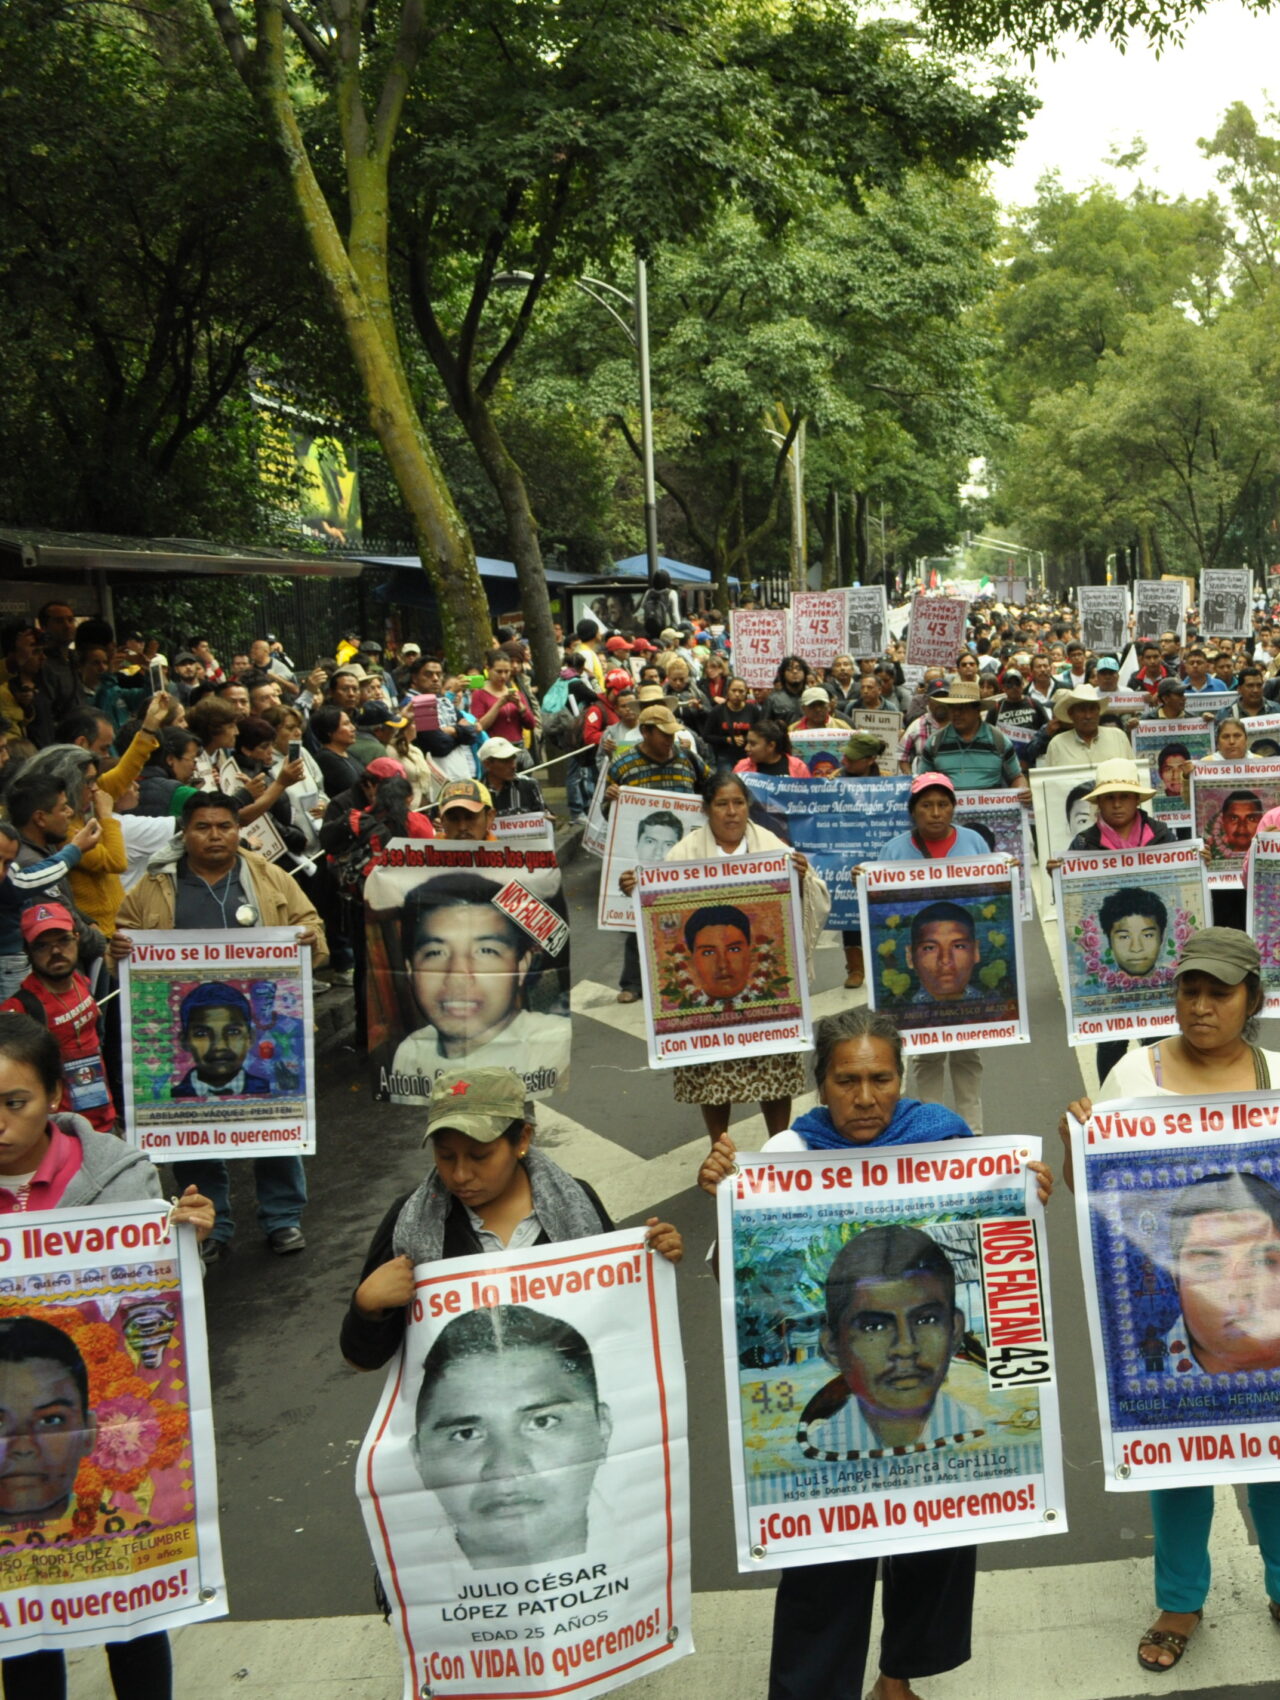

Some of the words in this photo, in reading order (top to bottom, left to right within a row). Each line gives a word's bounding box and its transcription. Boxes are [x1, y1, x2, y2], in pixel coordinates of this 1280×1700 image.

[809, 620, 830, 634] 43
[927, 622, 947, 636] 43
[750, 639, 771, 654] 43
[640, 867, 680, 886] ¡Vivo
[684, 867, 700, 880] se
[704, 865, 718, 878] lo
[723, 858, 787, 876] llevaron!
[496, 881, 523, 915] NOS
[517, 896, 559, 941] FALTAN
[131, 946, 175, 963] ¡Vivo
[181, 945, 199, 960] se
[205, 945, 220, 960] lo
[225, 944, 298, 960] llevaron!
[380, 1066, 433, 1097] Antonio
[149, 1111, 198, 1120] ABELARDO
[1088, 1112, 1156, 1144] ¡Vivo
[1165, 1113, 1193, 1135] se
[1199, 1106, 1224, 1133] lo
[141, 1133, 171, 1149] ¡Con
[176, 1131, 210, 1147] VIDA
[214, 1129, 228, 1144] lo
[230, 1126, 301, 1146] queremos!
[736, 1164, 813, 1200] ¡Vivo
[821, 1166, 853, 1190] se
[862, 1160, 888, 1188] lo
[897, 1149, 1021, 1185] llevaron!
[740, 1215, 757, 1224] Yo,
[762, 1213, 778, 1222] Jan
[782, 1211, 813, 1221] Nimmo,
[817, 1208, 859, 1219] Glasgow,
[939, 1198, 969, 1208] saber
[999, 1192, 1018, 1202] está
[22, 1216, 171, 1260] llevaron!
[982, 1220, 1036, 1266] NOS
[429, 1290, 461, 1317] se
[471, 1281, 500, 1311] lo
[510, 1255, 642, 1304] llevaron!
[986, 1269, 1043, 1347] FALTAN
[989, 1346, 1052, 1389] 43!
[751, 1380, 795, 1413] 43
[1120, 1399, 1170, 1412] MIGUEL
[1123, 1440, 1172, 1466] ¡Con
[1178, 1434, 1236, 1462] VIDA
[1240, 1432, 1261, 1458] lo
[795, 1475, 829, 1488] Luis
[889, 1460, 939, 1478] Abarca
[947, 1453, 1007, 1470] Carillo
[760, 1512, 812, 1545] ¡Con
[818, 1502, 879, 1534] VIDA
[884, 1499, 907, 1527] lo
[913, 1484, 1035, 1528] queremos!
[122, 1527, 191, 1556] TELUMBRE
[18, 1597, 44, 1626] lo
[51, 1568, 188, 1626] queremos!
[457, 1581, 518, 1600] JULIO
[525, 1562, 607, 1594] CÉSAR
[442, 1601, 508, 1622] LÓPEZ
[518, 1576, 629, 1617] PATOLZIN
[471, 1629, 518, 1643] EDAD
[524, 1626, 545, 1640] 25
[553, 1609, 609, 1636] AÑOS
[422, 1651, 465, 1685] ¡Con
[470, 1648, 520, 1679] VIDA
[524, 1646, 545, 1678] lo
[552, 1607, 661, 1677] queremos!
